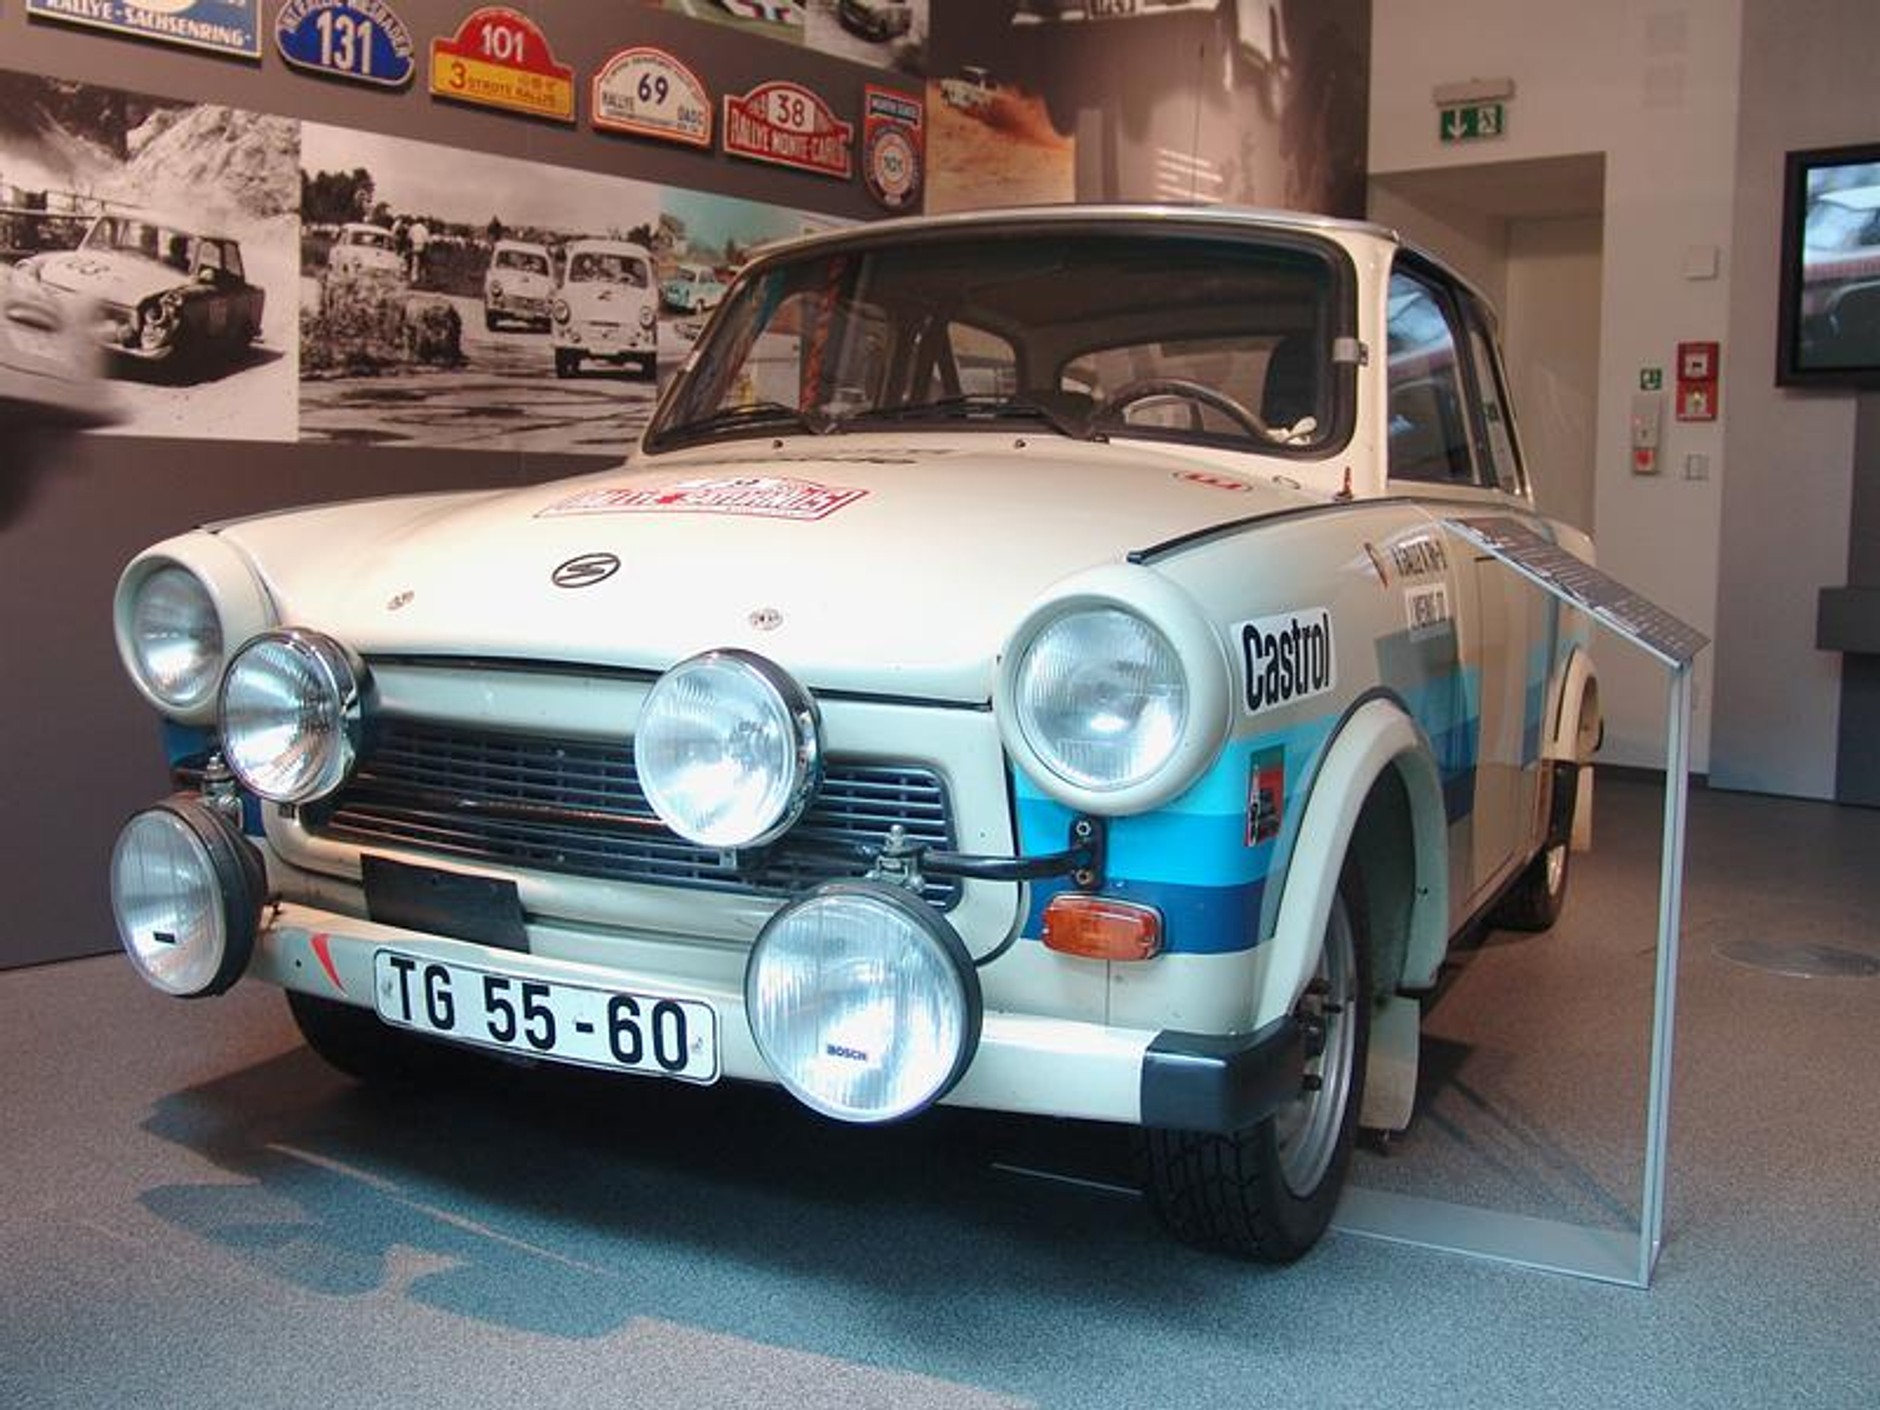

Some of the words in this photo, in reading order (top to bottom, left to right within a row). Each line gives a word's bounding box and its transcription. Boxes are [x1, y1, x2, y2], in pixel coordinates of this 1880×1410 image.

[317, 11, 371, 75] 131
[481, 24, 524, 62] 101
[450, 62, 466, 88] 3
[638, 73, 669, 105] 69
[731, 107, 770, 151] RALLYE
[777, 94, 804, 127] 38
[1242, 612, 1331, 710] Castrol
[390, 957, 455, 1030] TG
